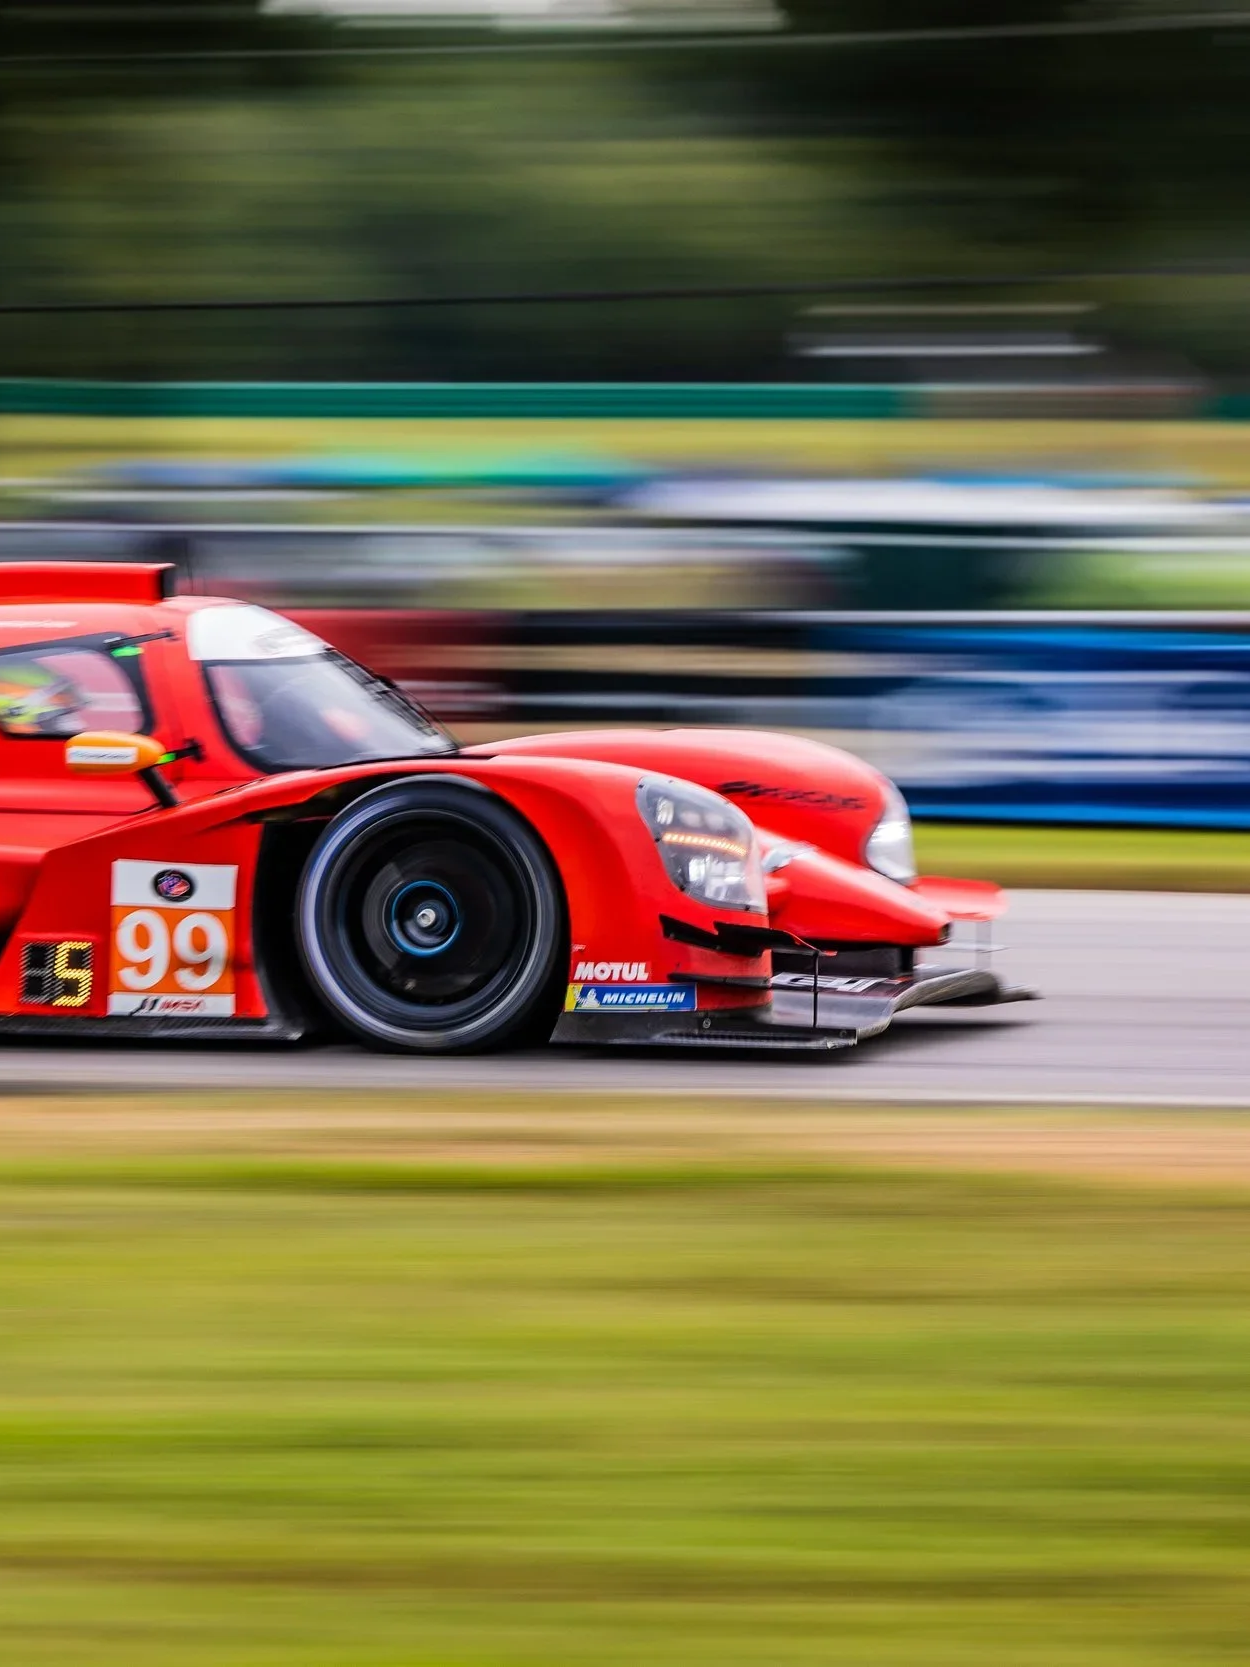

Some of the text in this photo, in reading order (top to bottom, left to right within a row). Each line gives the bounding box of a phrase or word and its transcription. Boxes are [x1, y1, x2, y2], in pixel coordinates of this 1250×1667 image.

[116, 909, 229, 991] 99
[573, 961, 650, 982] MOTUL
[601, 991, 687, 1005] MICHELIN
